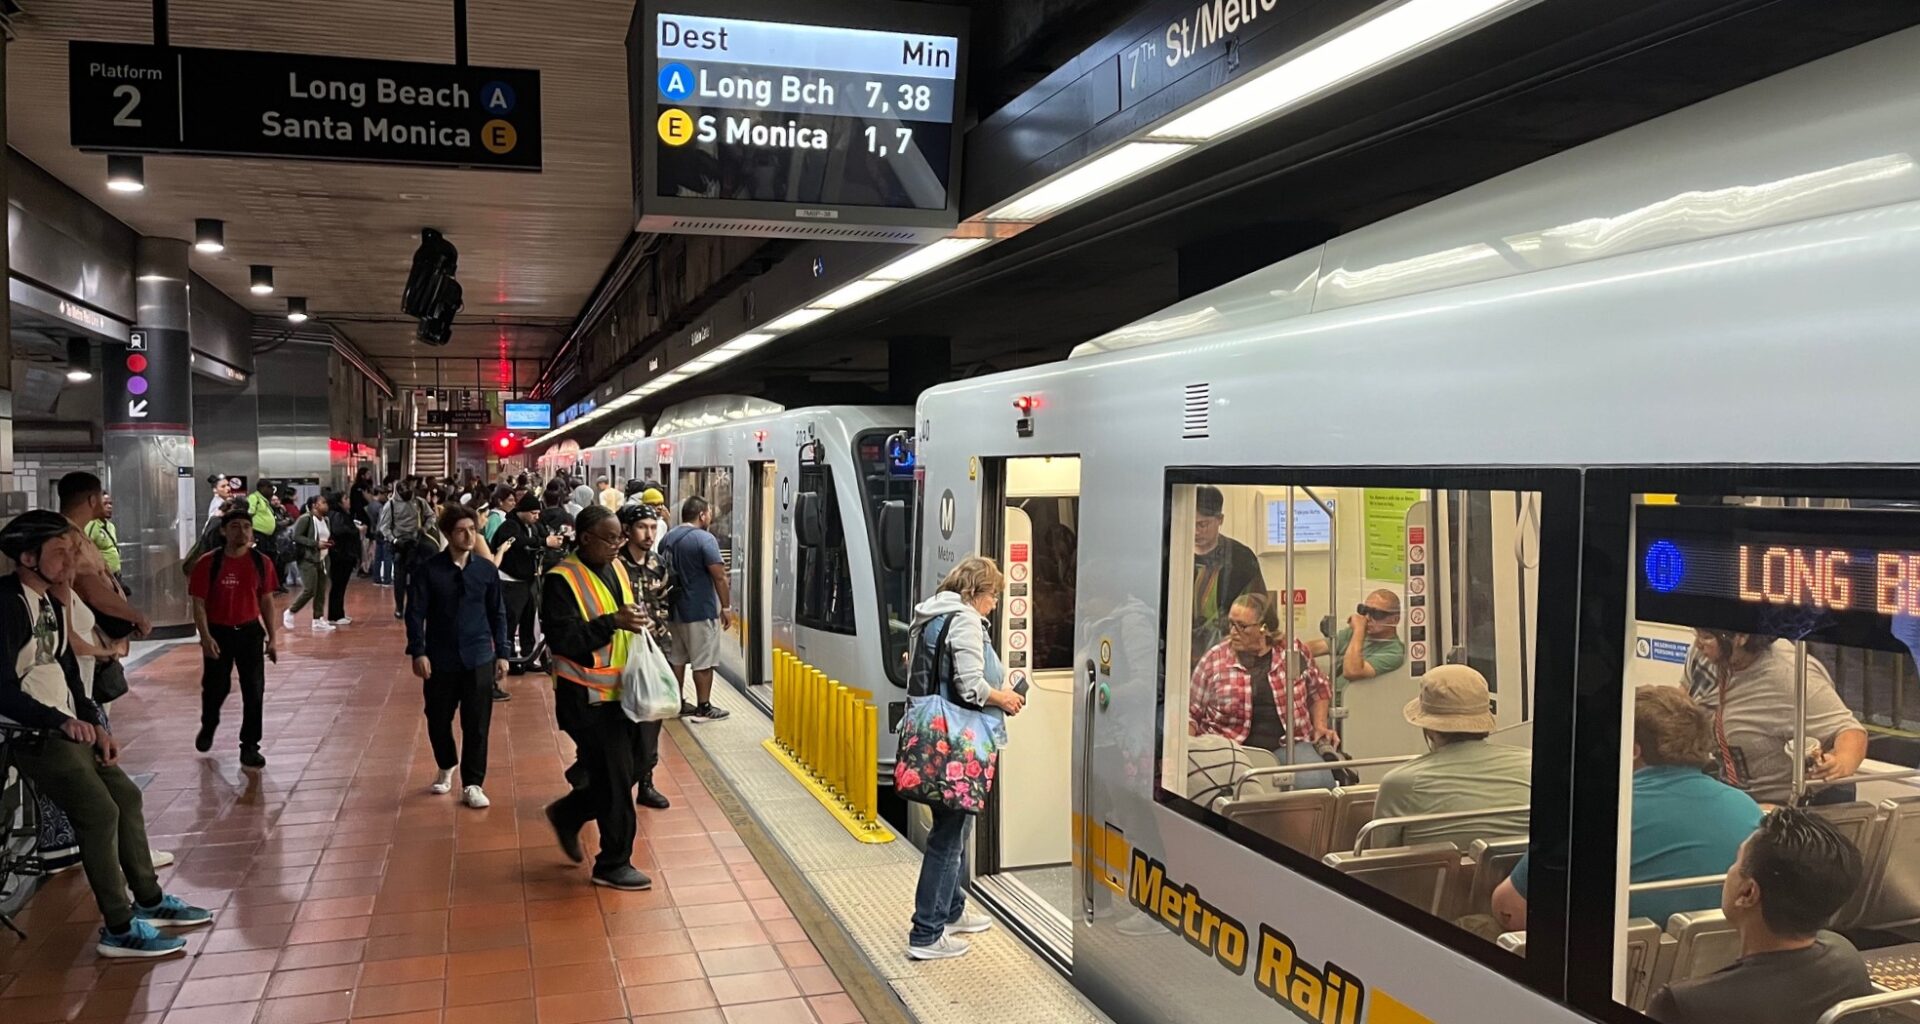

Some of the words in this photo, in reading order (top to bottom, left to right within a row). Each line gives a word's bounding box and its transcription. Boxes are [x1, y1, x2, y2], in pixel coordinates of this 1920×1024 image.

[661, 21, 728, 50] Dest
[902, 40, 950, 68] Min
[90, 62, 162, 80] Platform
[289, 72, 366, 108] Long
[377, 78, 470, 108] Beach
[488, 87, 508, 109] A
[666, 71, 685, 93] A
[700, 69, 772, 107] Long
[781, 76, 834, 105] Bch
[865, 82, 889, 113] 7,
[898, 85, 931, 112] 38
[113, 84, 142, 127] 2
[261, 111, 352, 141] Santa
[363, 117, 471, 147] Monica
[491, 126, 507, 147] E
[668, 117, 683, 138] E
[697, 115, 717, 143] S
[726, 117, 828, 150] Monica
[865, 126, 887, 157] 1,
[896, 128, 913, 154] 7
[938, 546, 954, 561] Metro
[1739, 545, 1850, 609] LONG
[1131, 852, 1248, 971] Metro
[1257, 929, 1361, 1024] Rail
